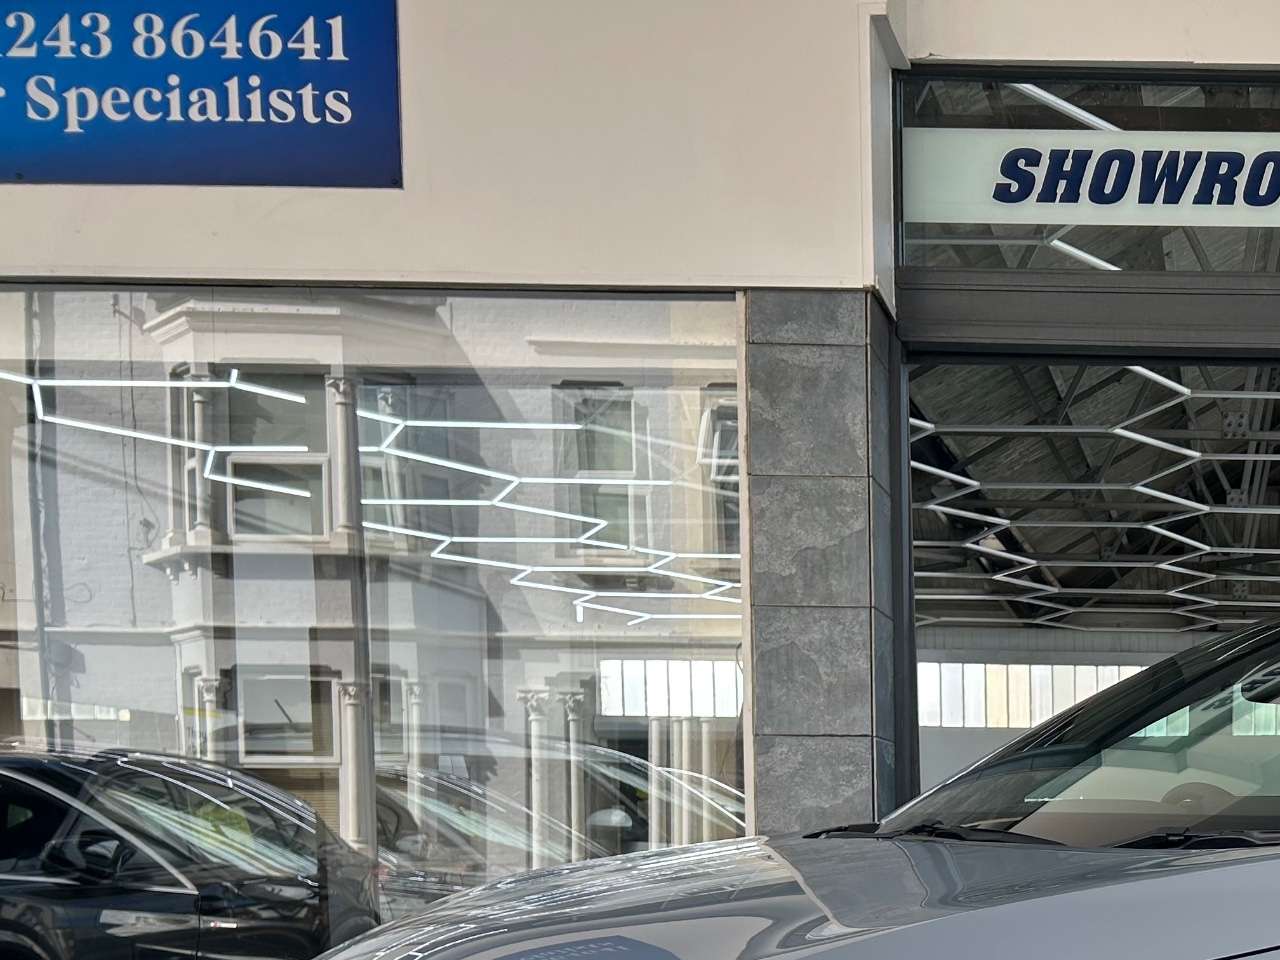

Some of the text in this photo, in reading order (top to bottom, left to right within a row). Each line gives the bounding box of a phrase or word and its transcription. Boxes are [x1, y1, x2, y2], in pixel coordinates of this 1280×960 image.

[0, 11, 349, 61] 243 864641
[25, 73, 352, 133] Specialists
